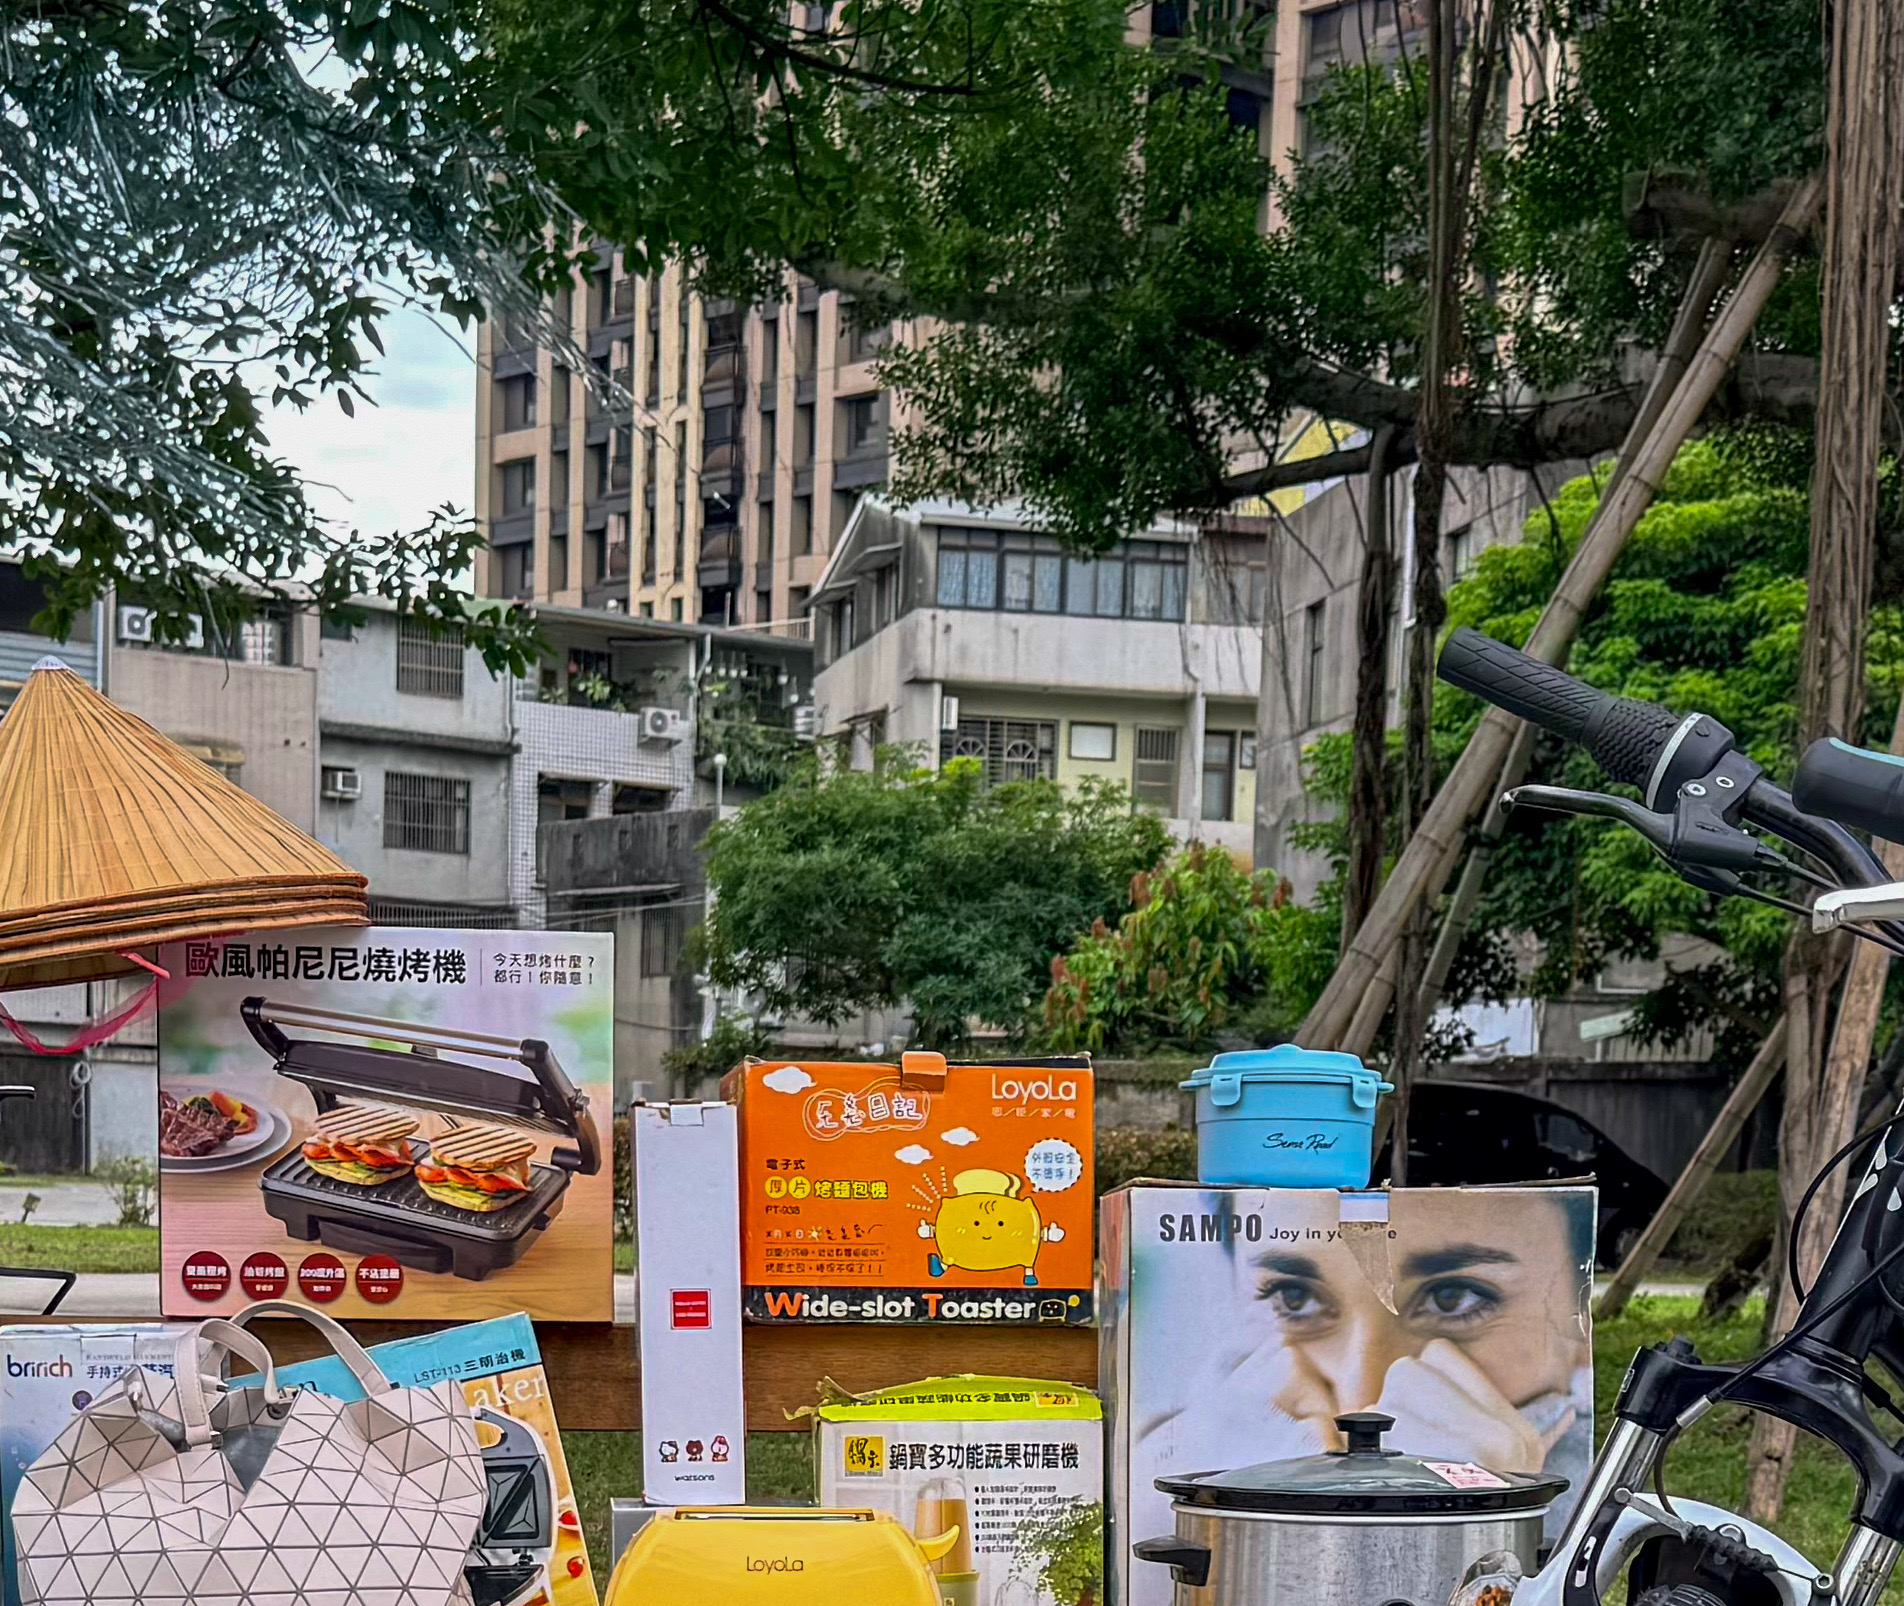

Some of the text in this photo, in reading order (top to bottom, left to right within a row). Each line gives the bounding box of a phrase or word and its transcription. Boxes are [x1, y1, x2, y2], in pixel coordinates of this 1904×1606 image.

[185, 942, 467, 985] 歐風帕尼尼燒烤機
[1159, 1214, 1263, 1243] SAMPO
[1269, 1228, 1300, 1242] Joy
[1306, 1227, 1321, 1240] in
[764, 1292, 1036, 1319] Wide-slot Toaster
[7, 1353, 73, 1378] bririch
[414, 1348, 526, 1384] LST-113 三明治機
[473, 1376, 545, 1407] aker
[889, 1441, 1080, 1471] 鍋寶多功能蔬果研磨機
